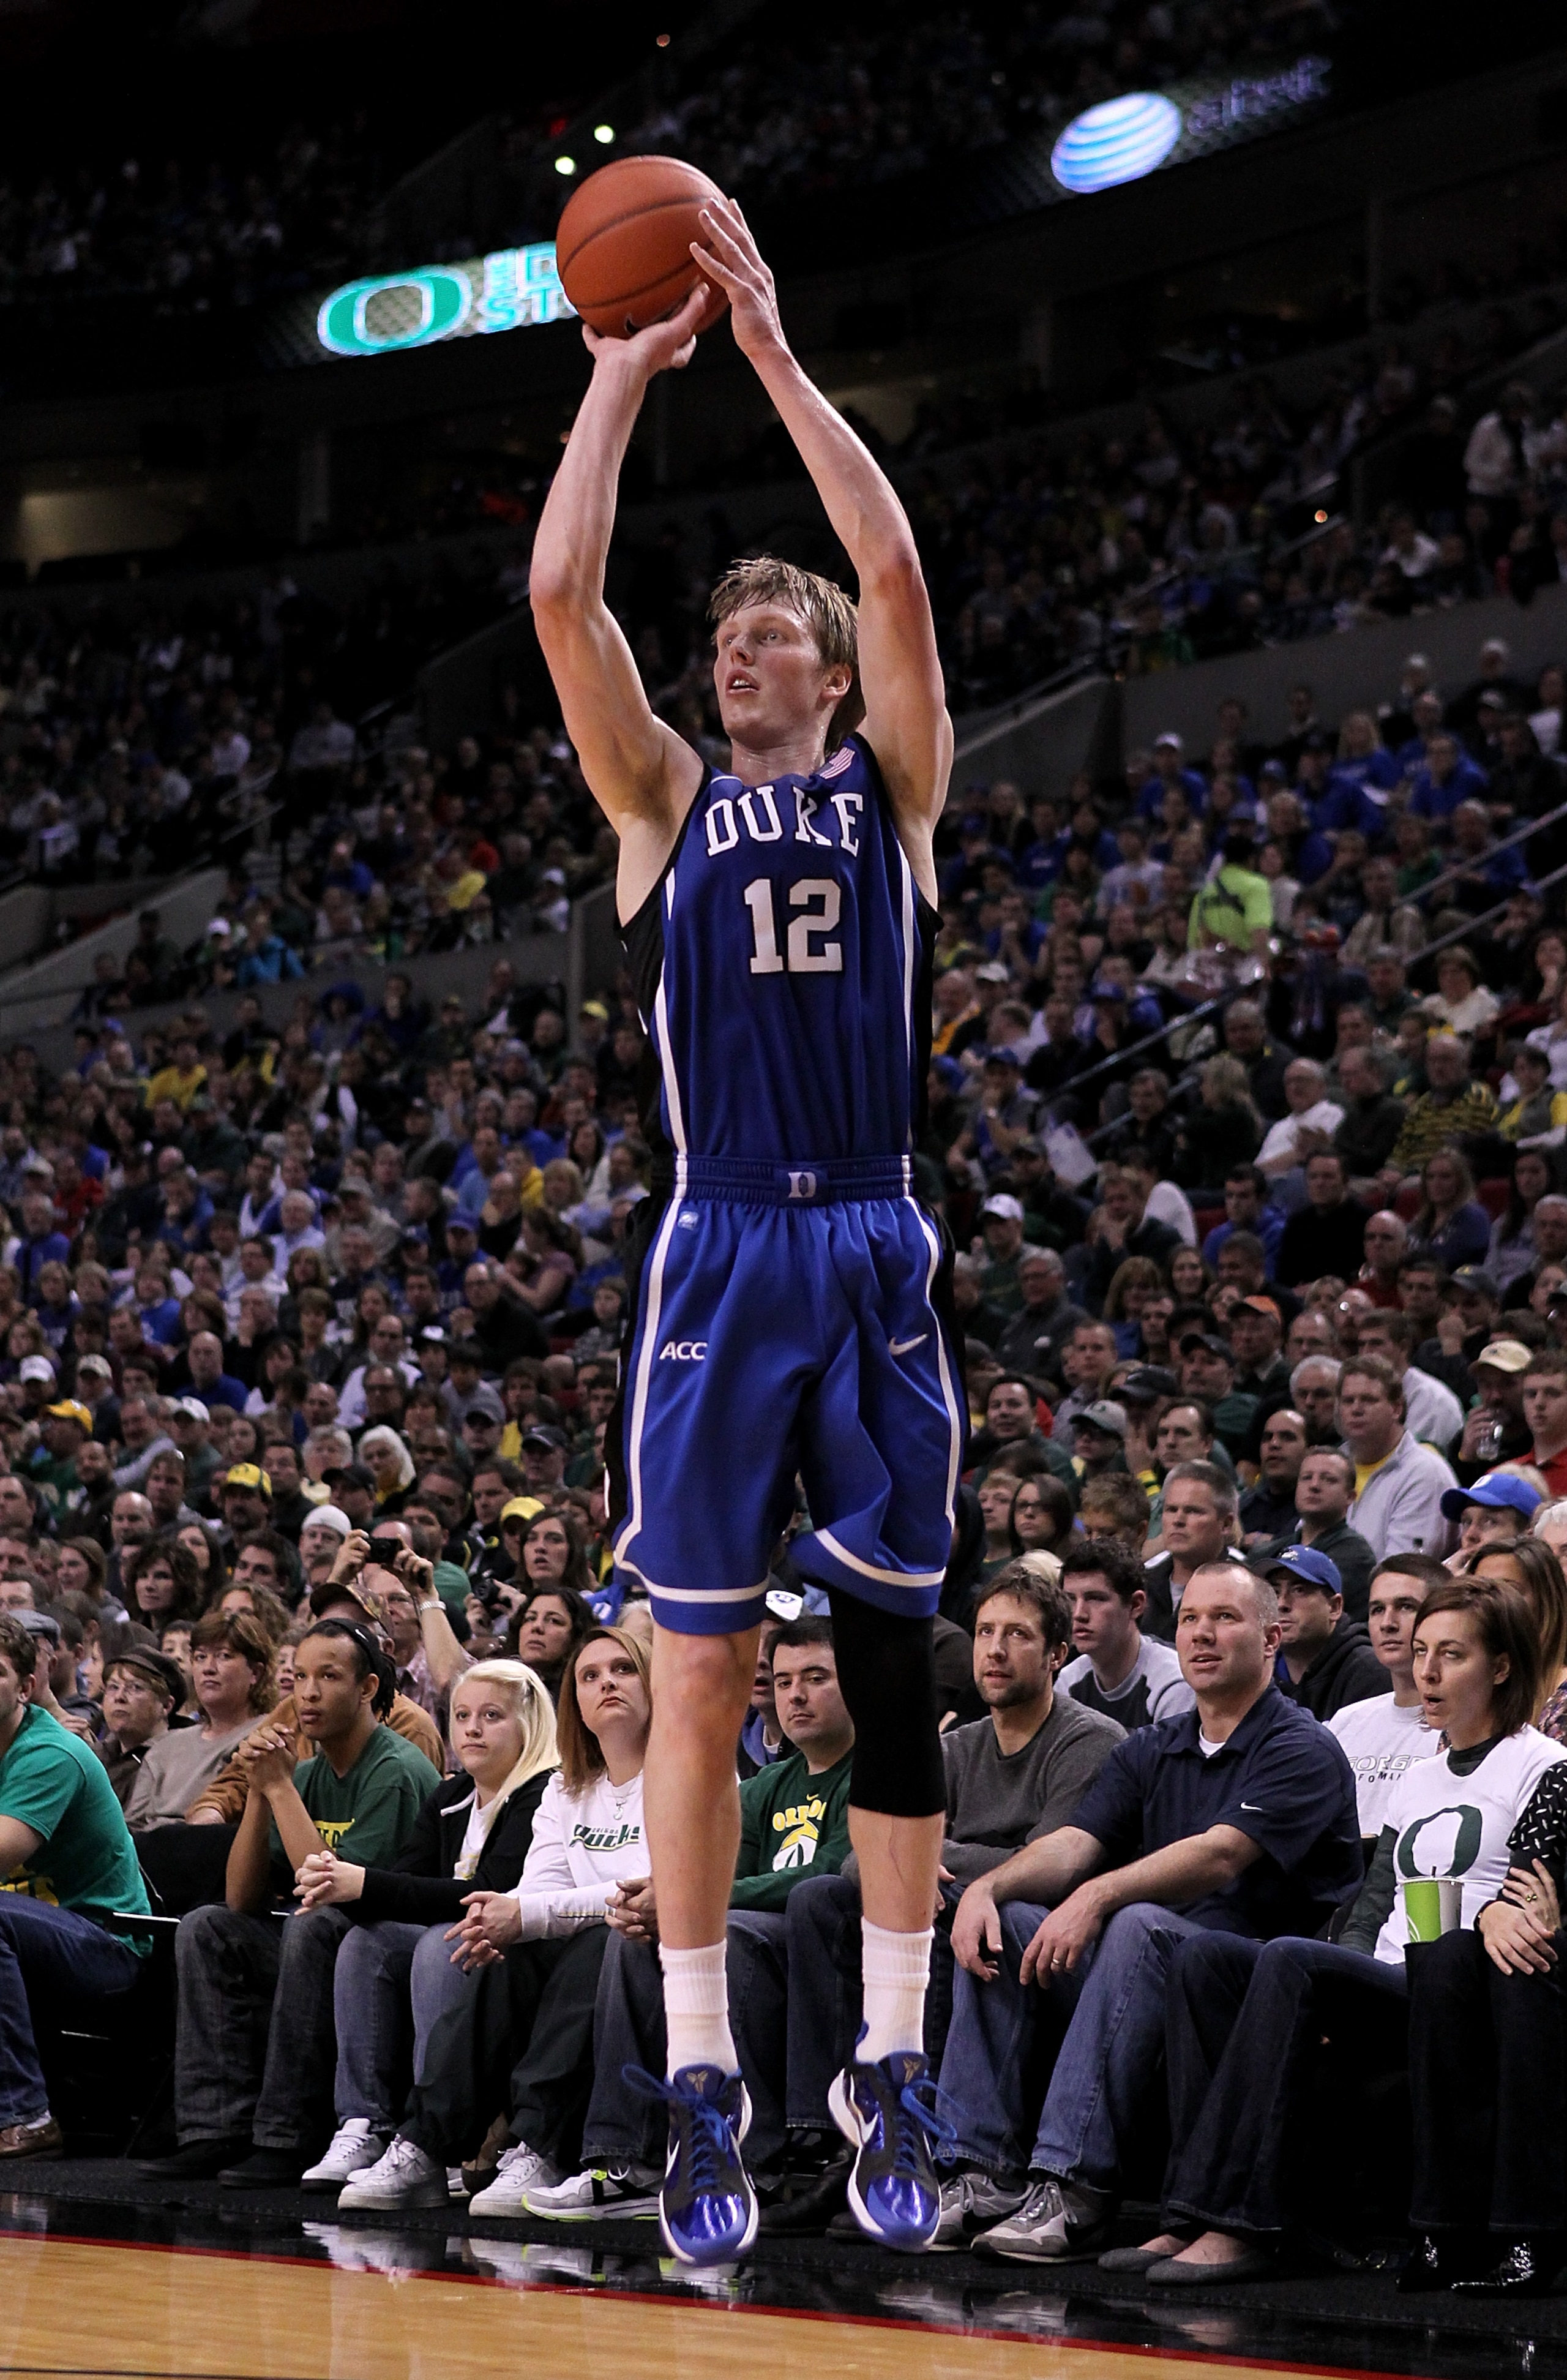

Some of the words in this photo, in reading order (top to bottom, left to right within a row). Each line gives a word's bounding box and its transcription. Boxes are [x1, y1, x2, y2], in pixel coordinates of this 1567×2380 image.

[705, 785, 864, 857] DUKE
[744, 877, 843, 974] 12
[659, 1341, 708, 1361] ACC
